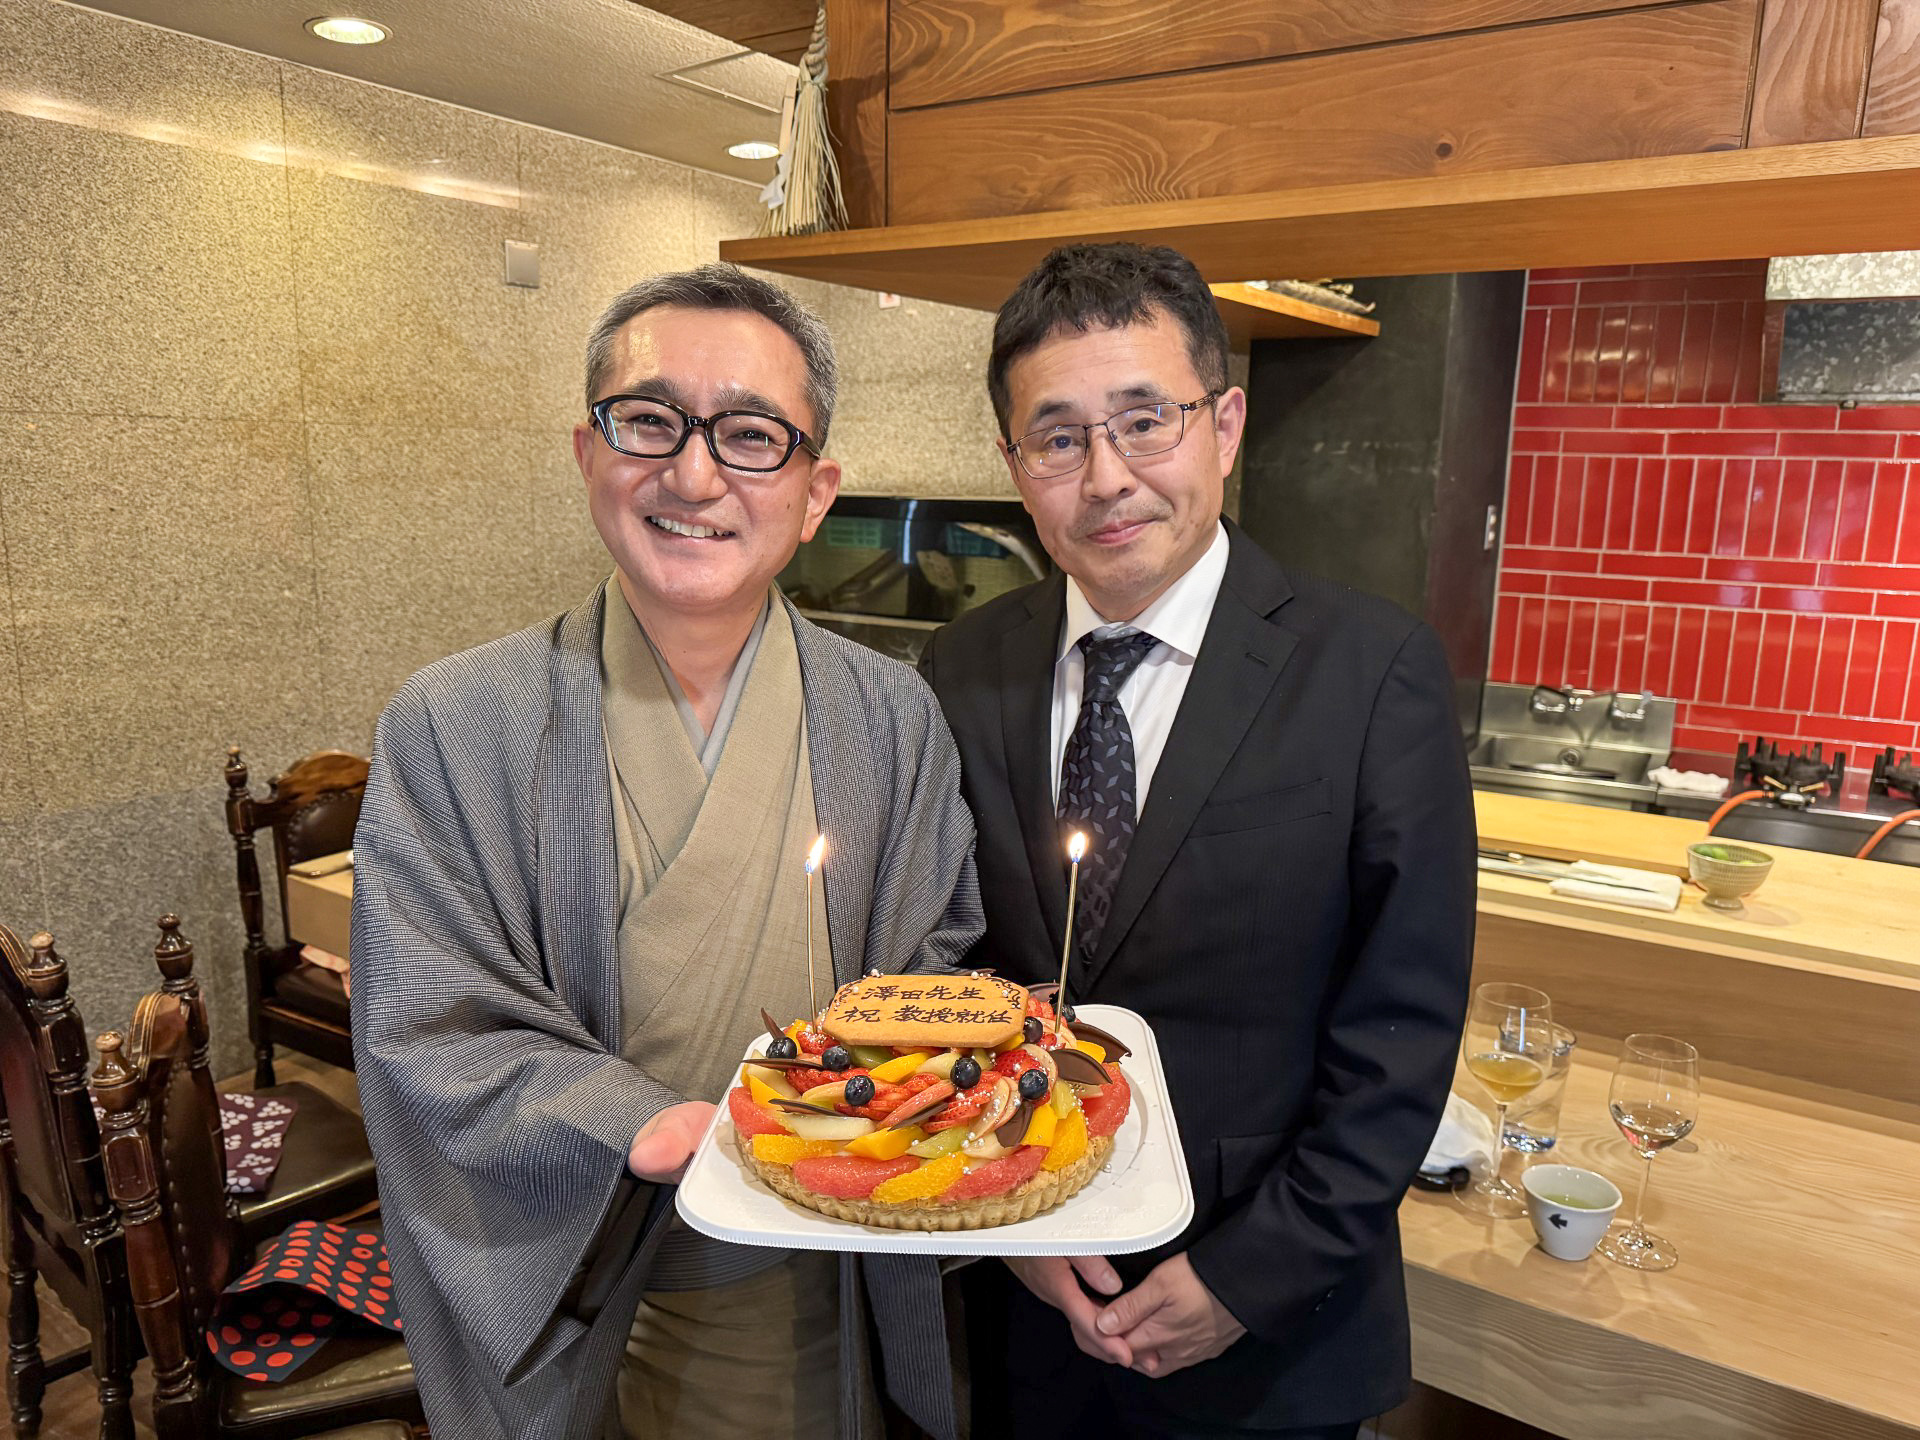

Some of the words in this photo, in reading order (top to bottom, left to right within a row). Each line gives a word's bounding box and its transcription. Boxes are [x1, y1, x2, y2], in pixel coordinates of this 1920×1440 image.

[861, 985, 986, 1001] 澤田先生
[836, 1006, 881, 1023] 祝
[888, 1005, 1013, 1024] 教授就任
